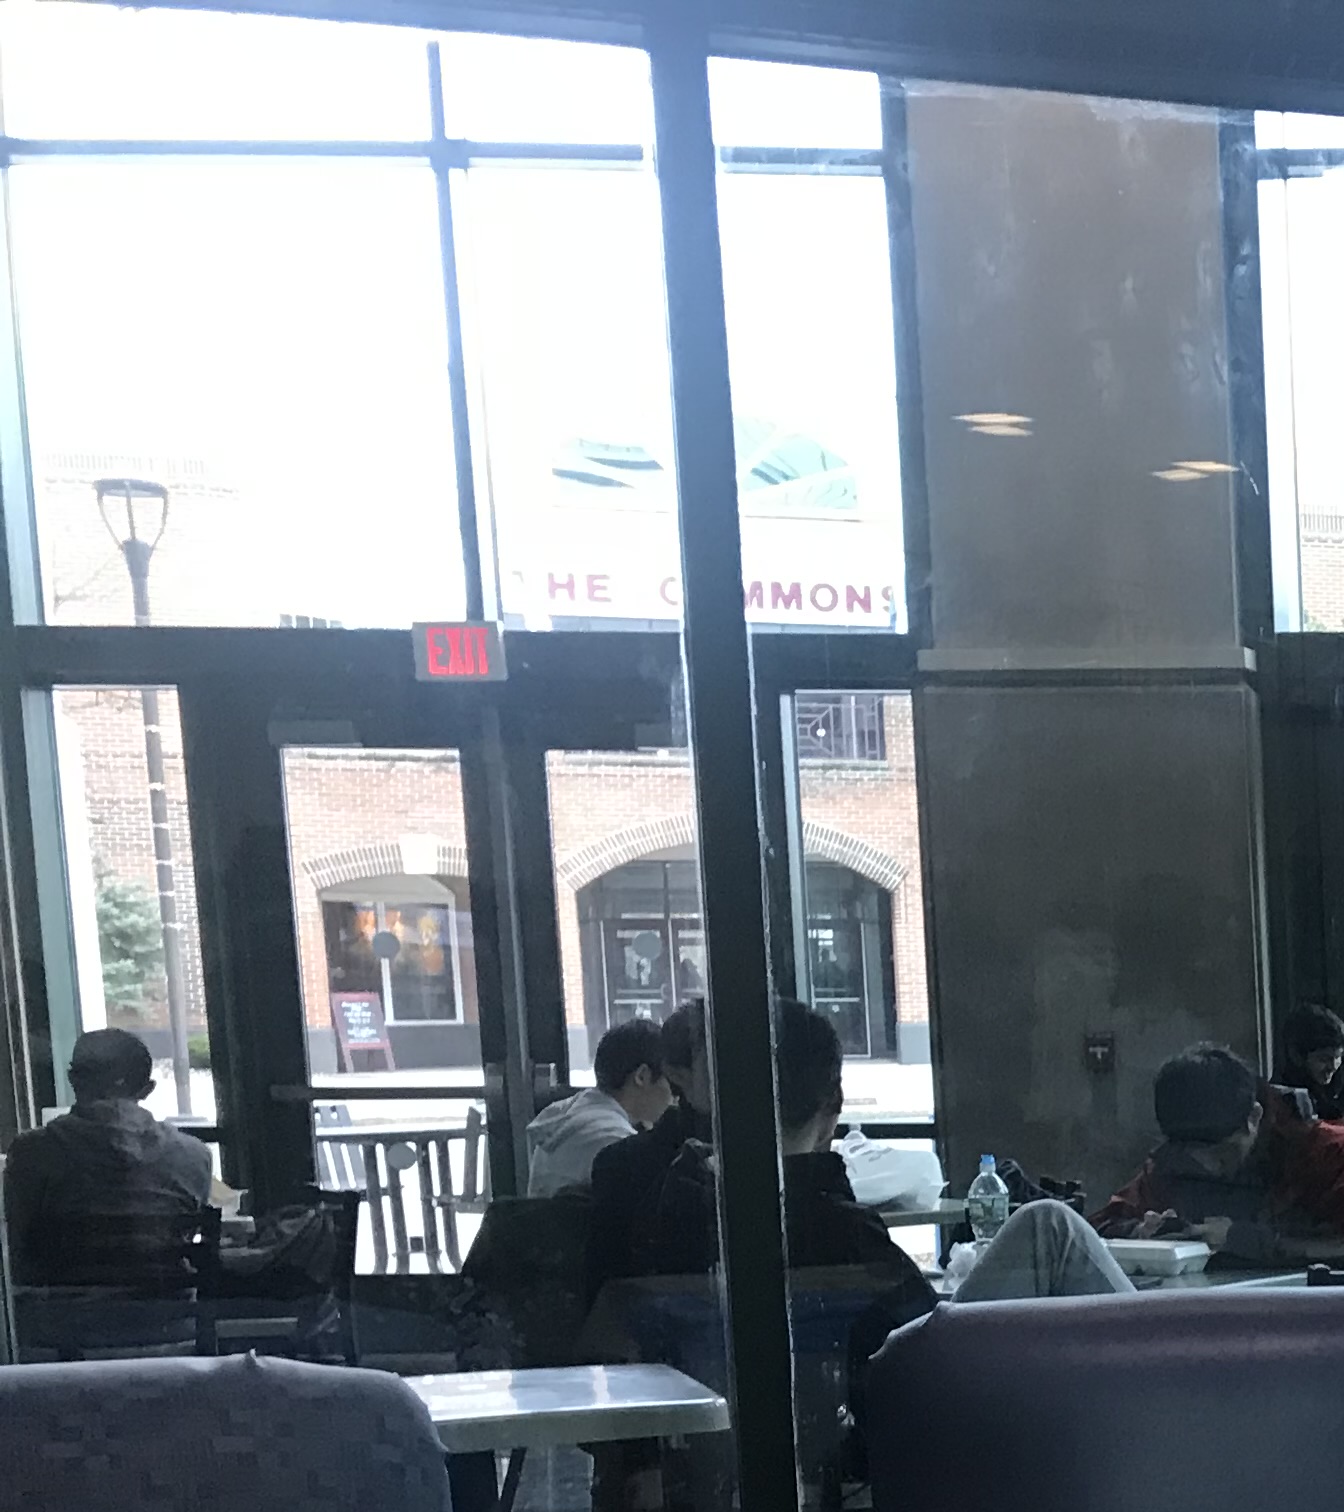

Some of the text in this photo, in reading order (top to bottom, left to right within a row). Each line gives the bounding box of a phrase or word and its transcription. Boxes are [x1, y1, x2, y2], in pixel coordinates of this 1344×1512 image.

[510, 570, 893, 614] HE CMMONS
[427, 627, 488, 677] EXIT
